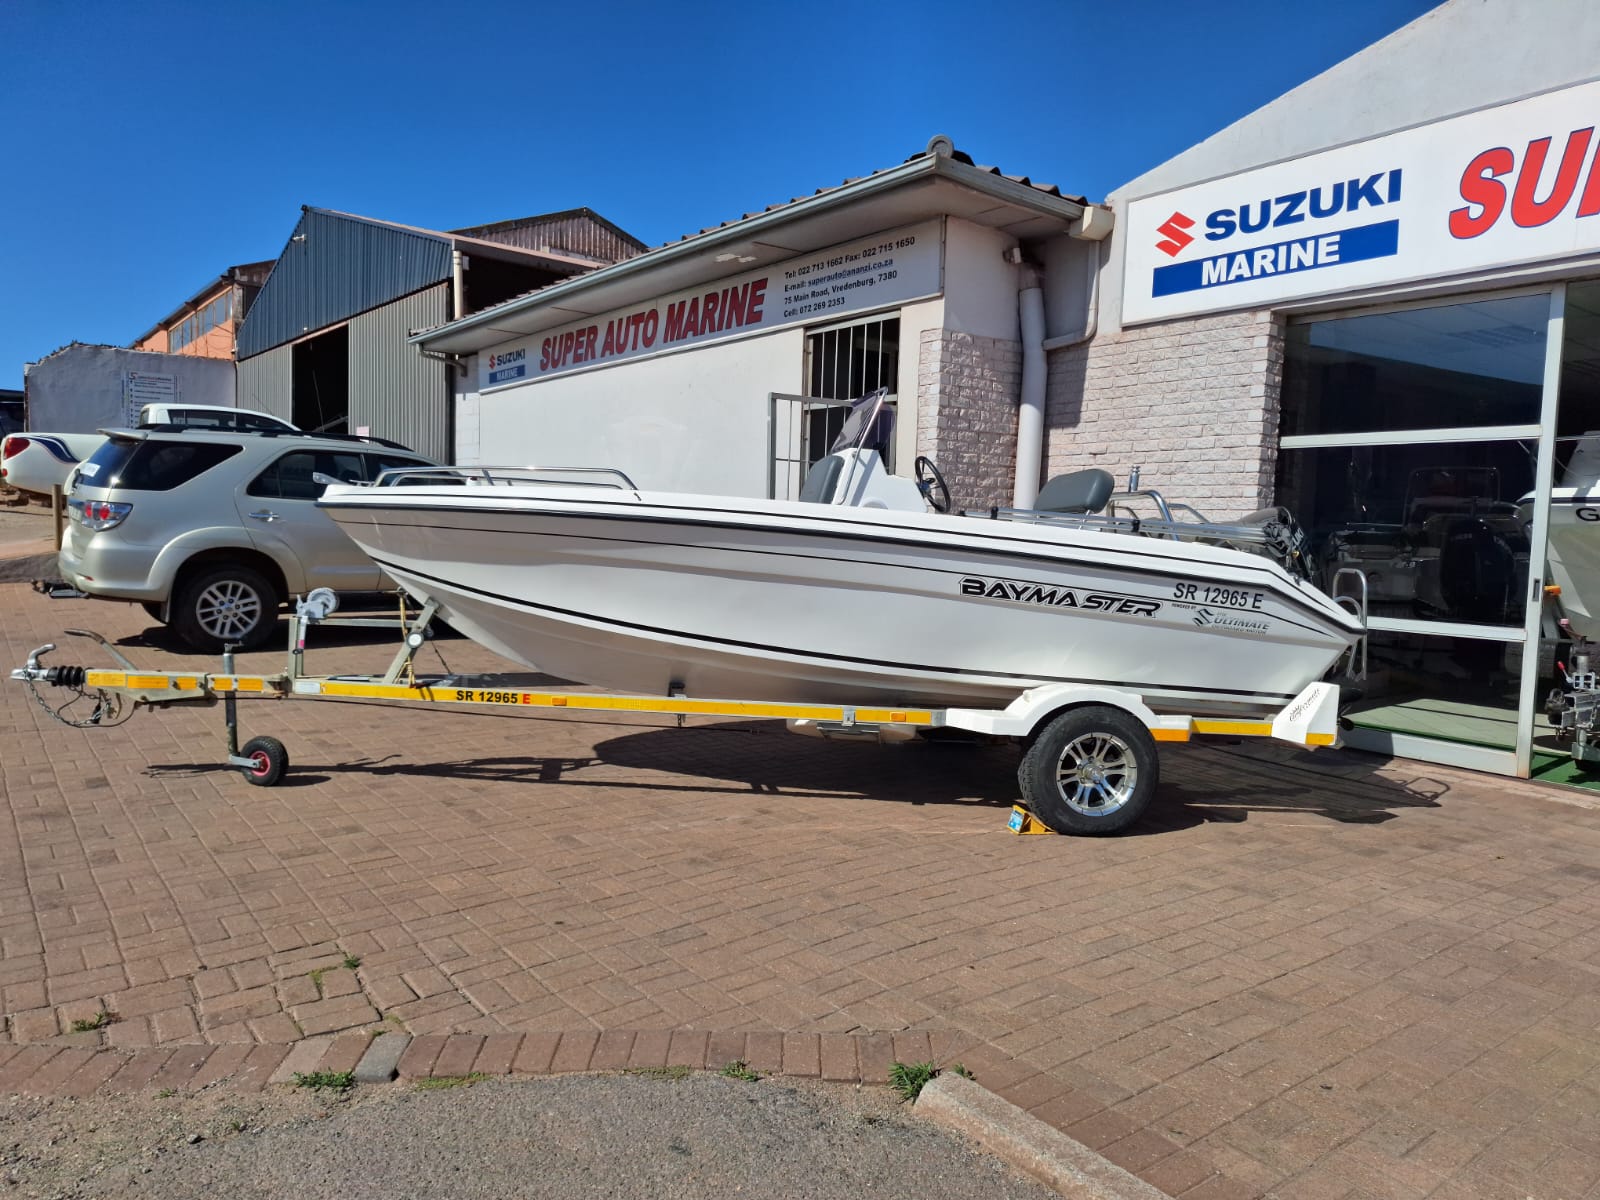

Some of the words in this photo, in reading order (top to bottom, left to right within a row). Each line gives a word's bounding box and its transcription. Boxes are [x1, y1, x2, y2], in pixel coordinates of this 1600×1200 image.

[1204, 168, 1402, 242] SUZUKI
[785, 270, 797, 279] Tel:
[797, 265, 811, 276] 022
[812, 262, 825, 272] 713
[827, 257, 843, 268] 1662
[845, 253, 861, 263] Fax:
[862, 248, 876, 258] 022
[879, 242, 893, 253] 715
[895, 236, 915, 249] 1650
[1201, 234, 1340, 286] MARINE
[784, 281, 807, 292] E-mail:
[784, 297, 792, 305] 75
[793, 293, 810, 303] Main
[811, 288, 830, 299] Road,
[878, 270, 898, 282] 7380
[540, 325, 599, 371] SUPER
[600, 308, 658, 358] AUTO
[663, 277, 769, 343] MARINE
[783, 308, 798, 318] Cell:
[799, 304, 812, 314] 072
[813, 301, 826, 311] 269
[828, 297, 845, 308] 2353
[496, 349, 526, 366] SUZUKI
[961, 577, 1163, 617] BAYMASTER
[1173, 582, 1198, 600] SR
[1204, 586, 1249, 607] 12965
[1252, 593, 1264, 609] E
[456, 690, 474, 701] SR
[479, 691, 518, 704] 12965
[522, 693, 531, 704] E
